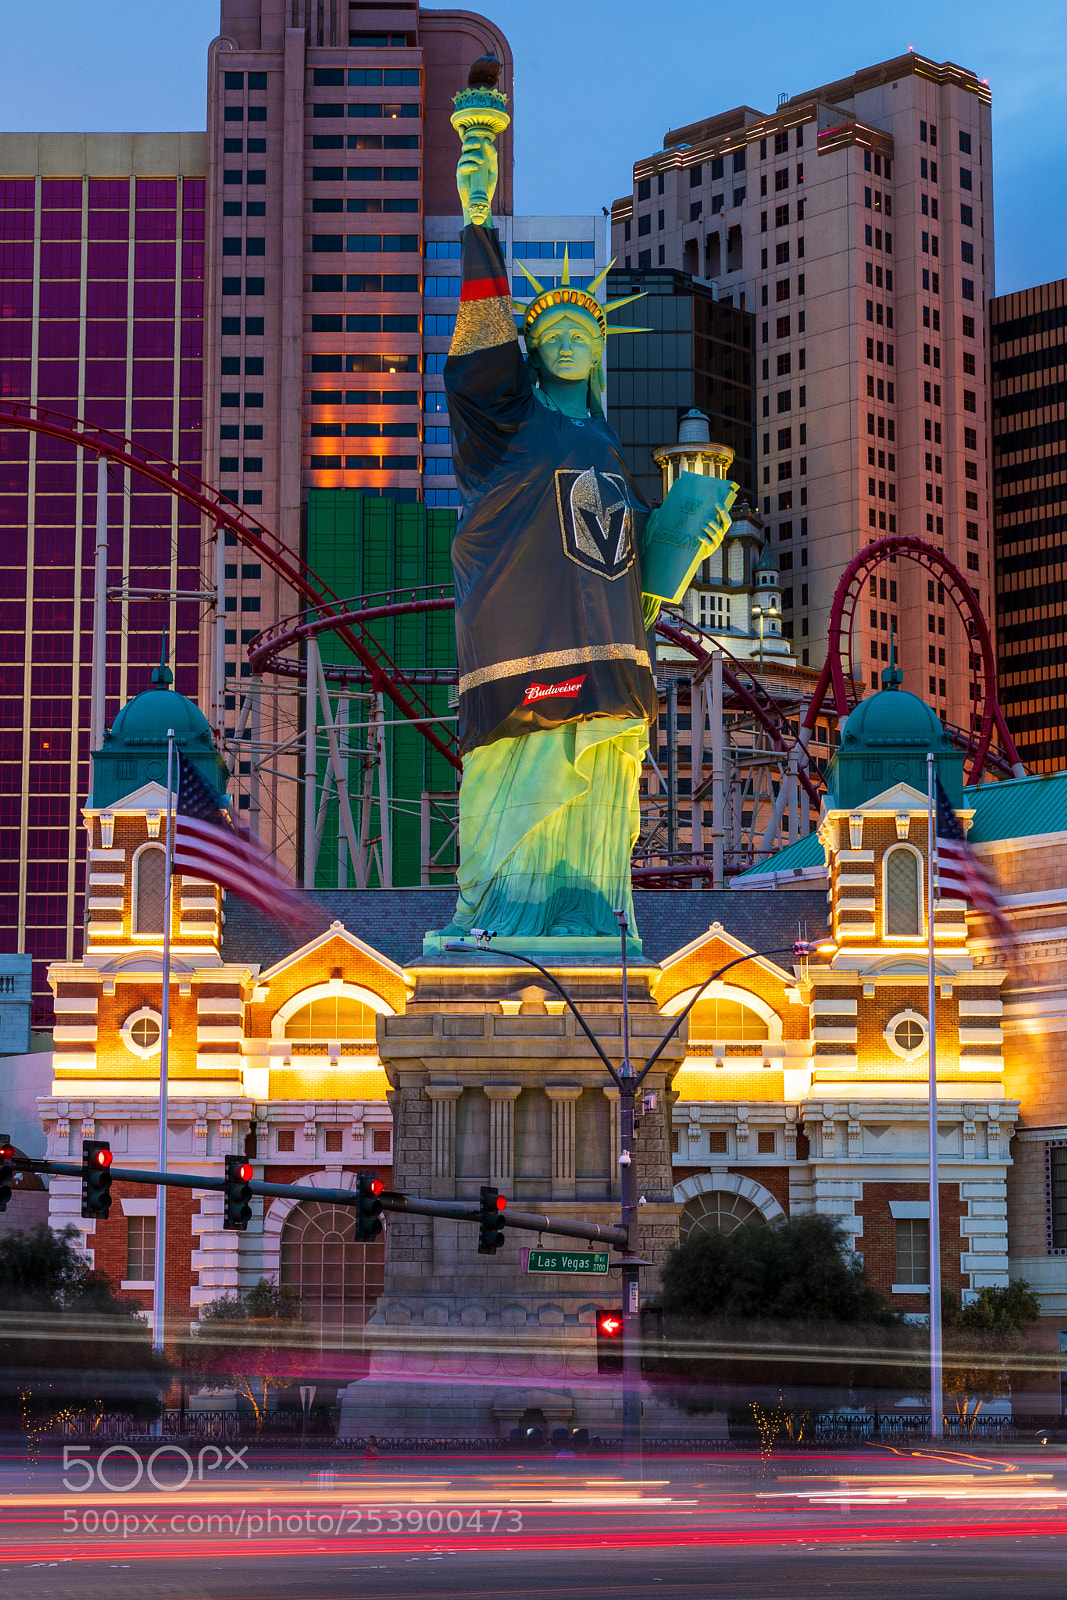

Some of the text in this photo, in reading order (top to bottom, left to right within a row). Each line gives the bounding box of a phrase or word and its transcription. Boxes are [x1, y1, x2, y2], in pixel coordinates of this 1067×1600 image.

[525, 683, 582, 699] Budweiser
[538, 1255, 557, 1267] Las
[562, 1256, 590, 1271] Vegas
